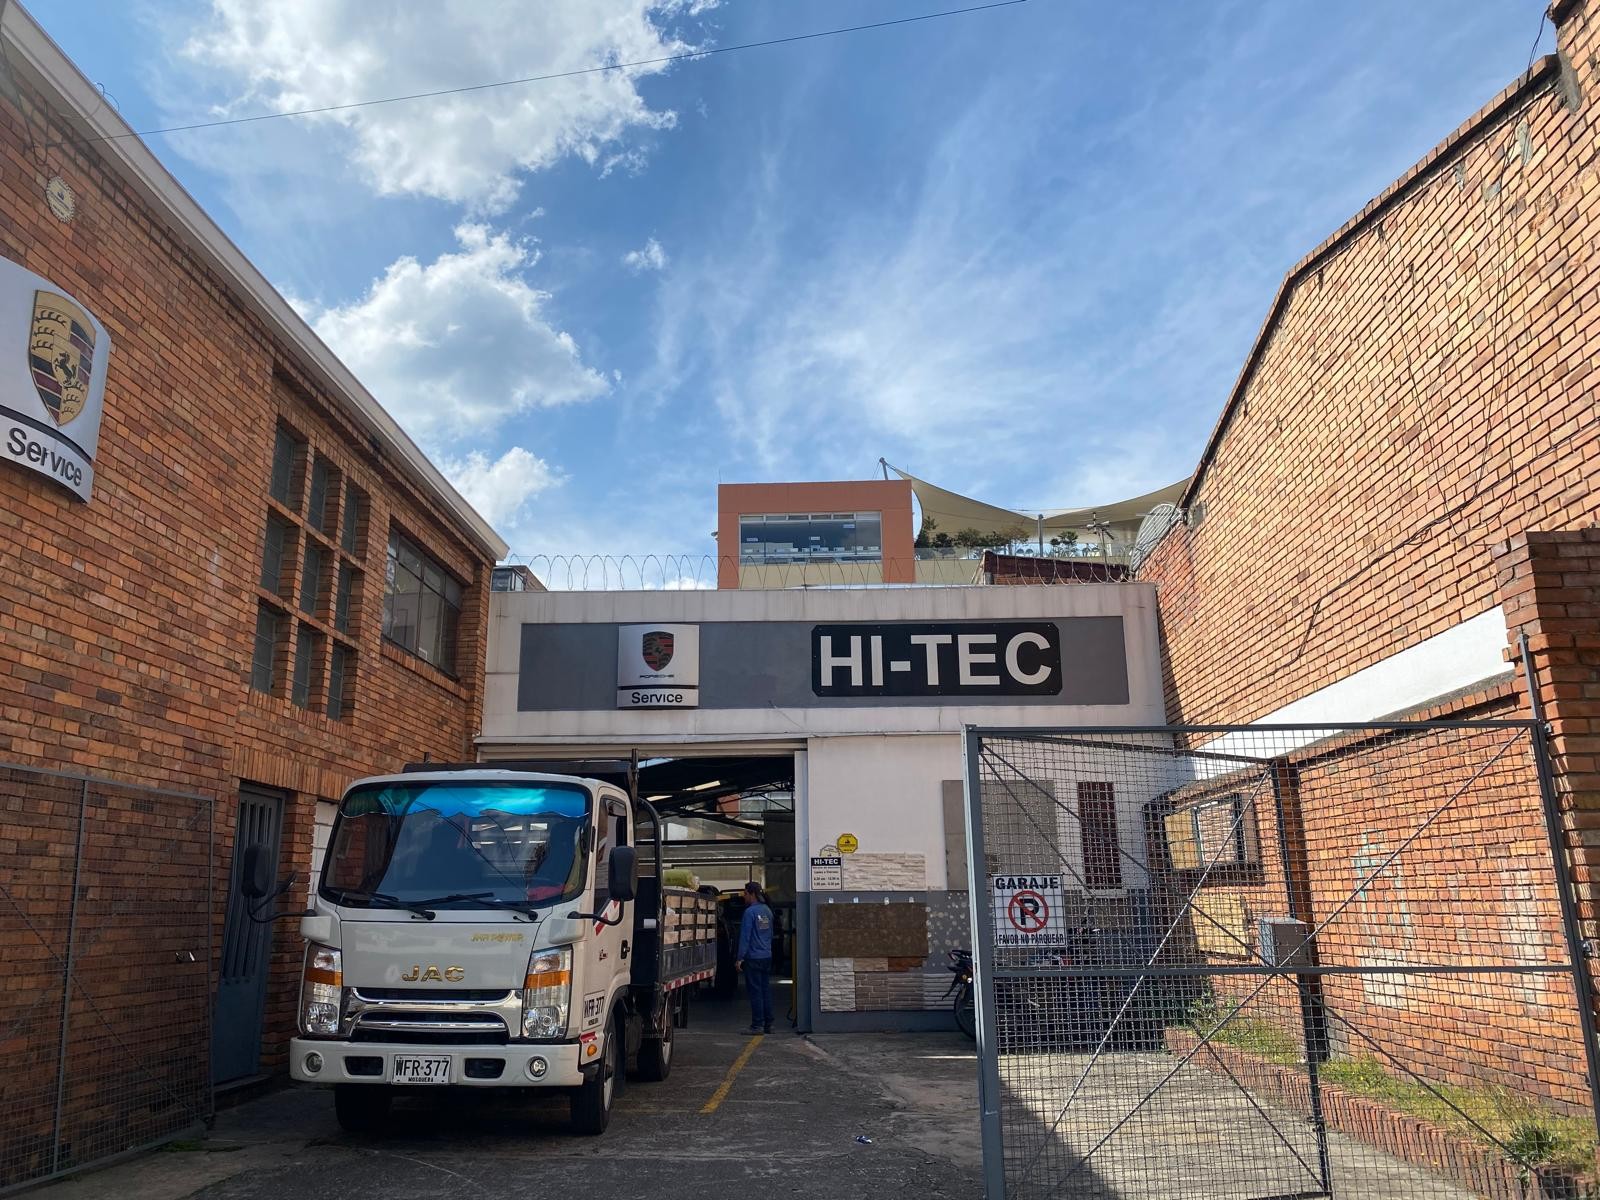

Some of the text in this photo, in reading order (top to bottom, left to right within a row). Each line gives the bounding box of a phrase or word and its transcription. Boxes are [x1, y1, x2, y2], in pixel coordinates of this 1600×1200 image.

[6, 427, 82, 487] Service
[820, 631, 1052, 688] HI-TEC
[631, 692, 683, 704] Service
[995, 876, 1059, 890] GARAJE
[998, 933, 1065, 945] FAVOR NO PARQUEAR
[401, 965, 465, 982] JAC
